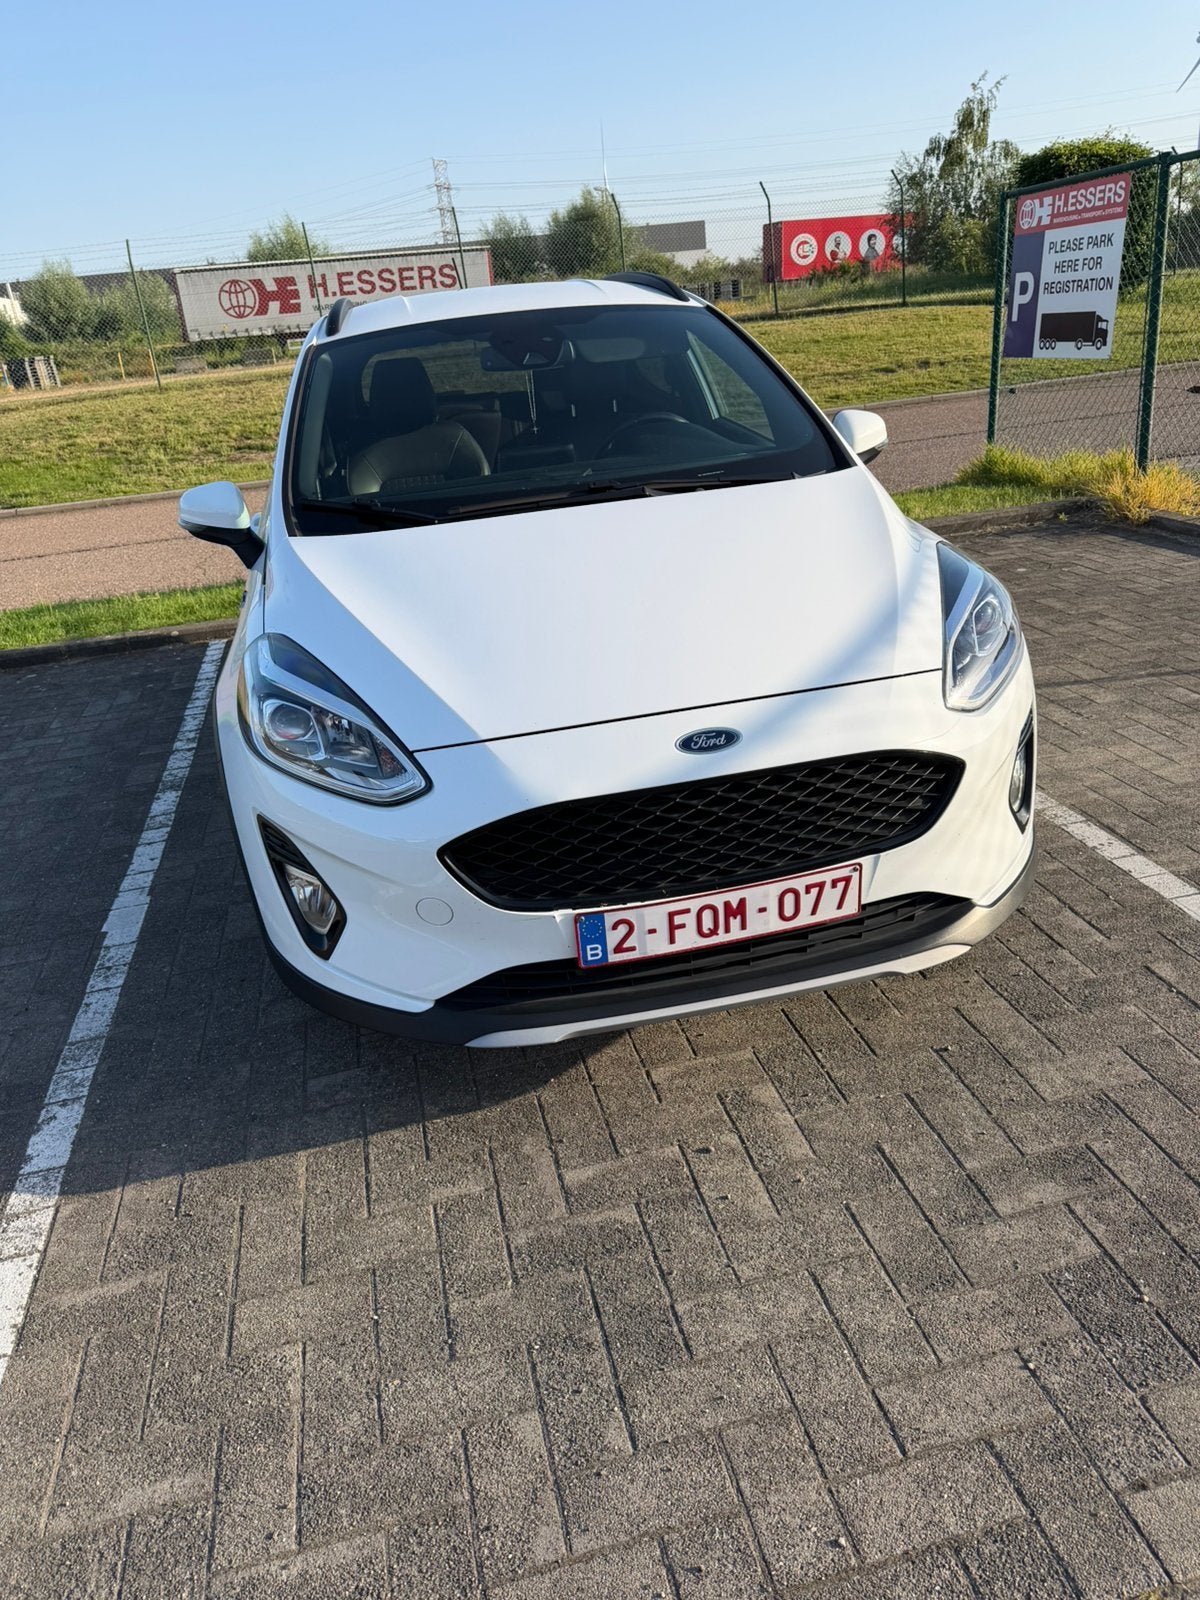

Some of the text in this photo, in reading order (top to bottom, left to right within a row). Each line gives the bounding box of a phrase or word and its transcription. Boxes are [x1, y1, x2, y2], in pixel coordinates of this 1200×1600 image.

[1054, 181, 1126, 214] H.ESSERS
[1048, 232, 1115, 254] PLEASE PARK
[1054, 256, 1103, 274] HERE FOR
[307, 263, 458, 299] H.ESSERS
[1043, 276, 1114, 295] REGISTRATION
[1011, 271, 1035, 322] P
[691, 732, 726, 749] Ford
[611, 875, 853, 954] 2-FQM-077
[586, 944, 602, 961] B
